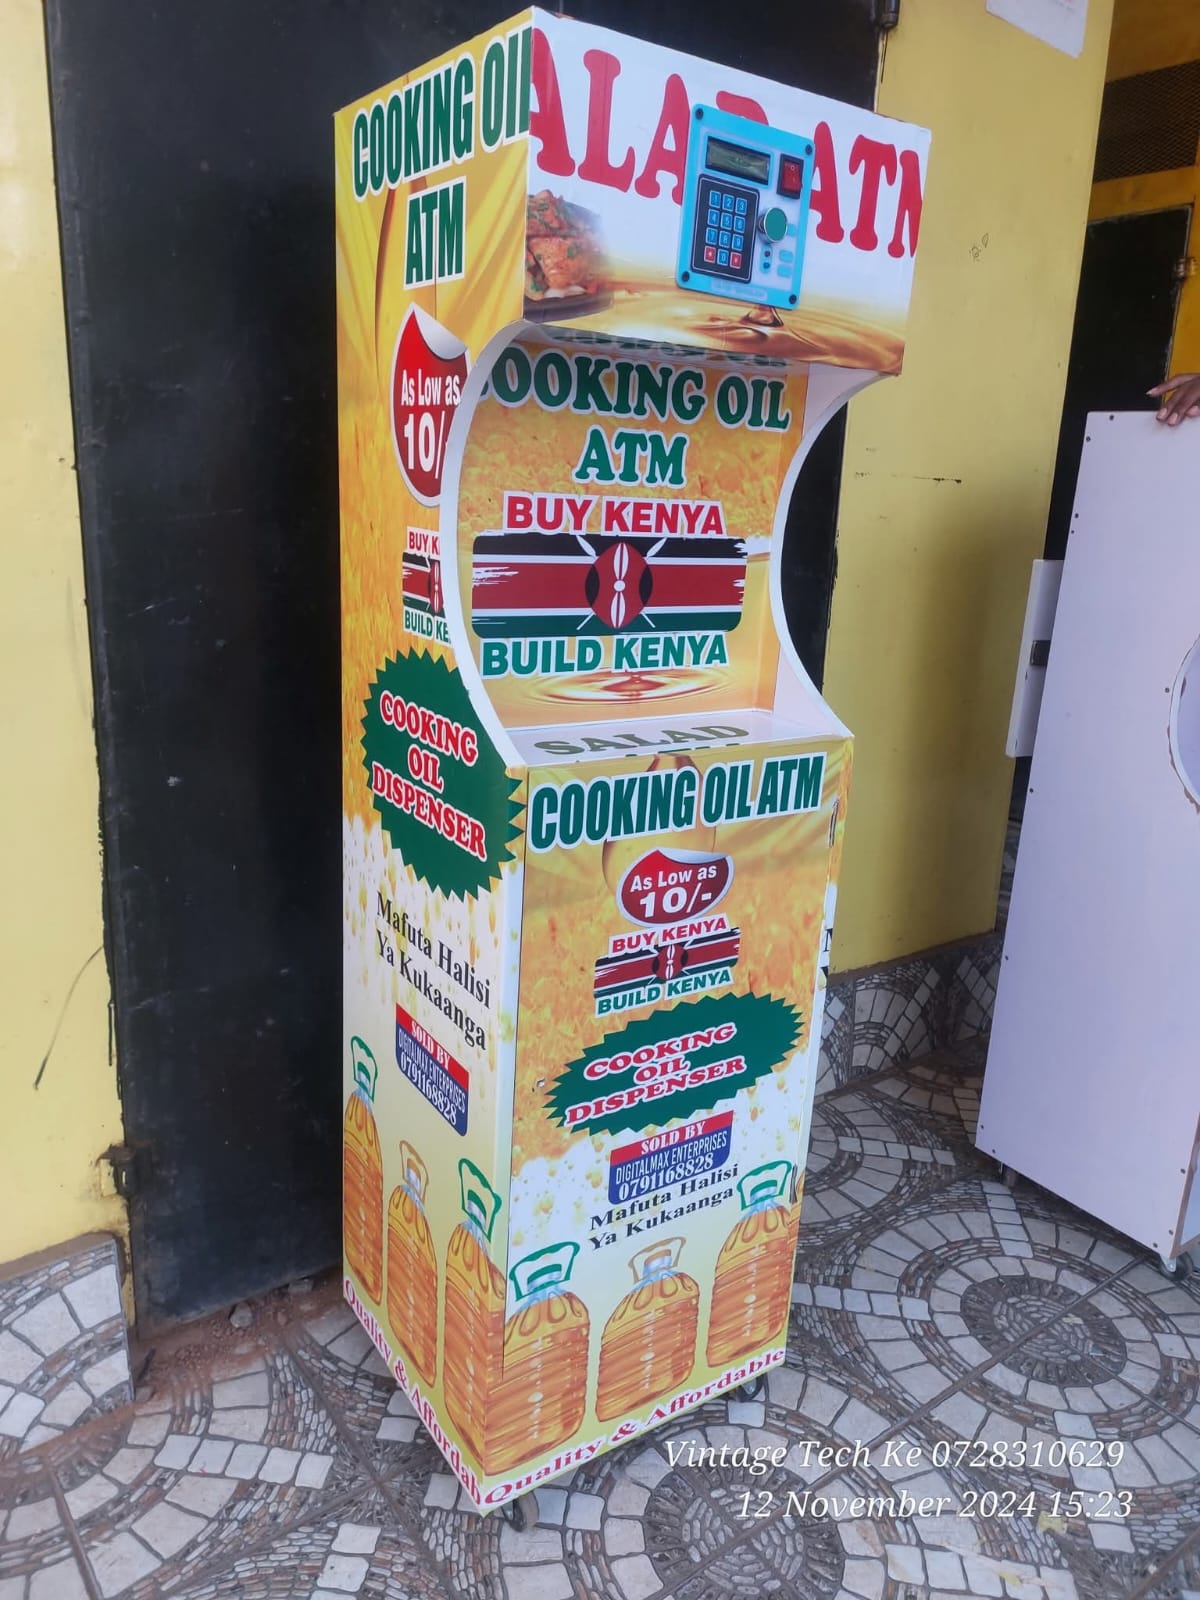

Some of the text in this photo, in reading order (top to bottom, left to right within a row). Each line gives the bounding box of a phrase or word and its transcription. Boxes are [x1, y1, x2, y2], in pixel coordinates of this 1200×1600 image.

[354, 57, 473, 198] COOKING
[405, 183, 464, 284] ATM
[401, 368, 460, 406] As Low as
[480, 346, 706, 422] OOKING
[717, 375, 790, 431] OIL
[404, 410, 447, 479] 10/
[575, 430, 688, 485] ATM
[409, 531, 429, 552] BUY
[507, 496, 724, 535] BUY KENYA
[405, 609, 451, 644] BUILD KE
[482, 634, 727, 676] BUILD KENYA
[381, 693, 477, 763] COOKING
[534, 726, 750, 755] SALAD
[409, 747, 442, 790] OIL
[373, 764, 485, 858] DISPENSER
[531, 755, 824, 849] COOKING OIL ATM
[630, 864, 717, 892] As Low as
[639, 883, 712, 918] 10/-
[377, 891, 490, 1009] Mafuta Halisi
[612, 917, 727, 953] BUY KENYA
[377, 929, 486, 1050] Ya Kukaanga
[598, 970, 731, 1015] BUILD KENYA
[411, 1020, 450, 1071] SOLD BY
[586, 1025, 736, 1079] COOKING
[635, 1058, 688, 1084] OIL
[401, 1052, 456, 1125] 0791168828
[429, 1060, 466, 1114] ENTERPRISES
[567, 1057, 744, 1124] DISPENSER
[641, 1121, 706, 1155] SOLD BY
[671, 1131, 727, 1165] ENTERPRISES
[590, 1164, 738, 1231] Mafuta Halisi
[618, 1152, 714, 1201] 0791168828
[589, 1188, 733, 1250] Ya Kukaanga
[345, 1279, 392, 1363] Quality
[394, 1359, 407, 1389] &
[485, 1349, 785, 1505] Quality & Affordable
